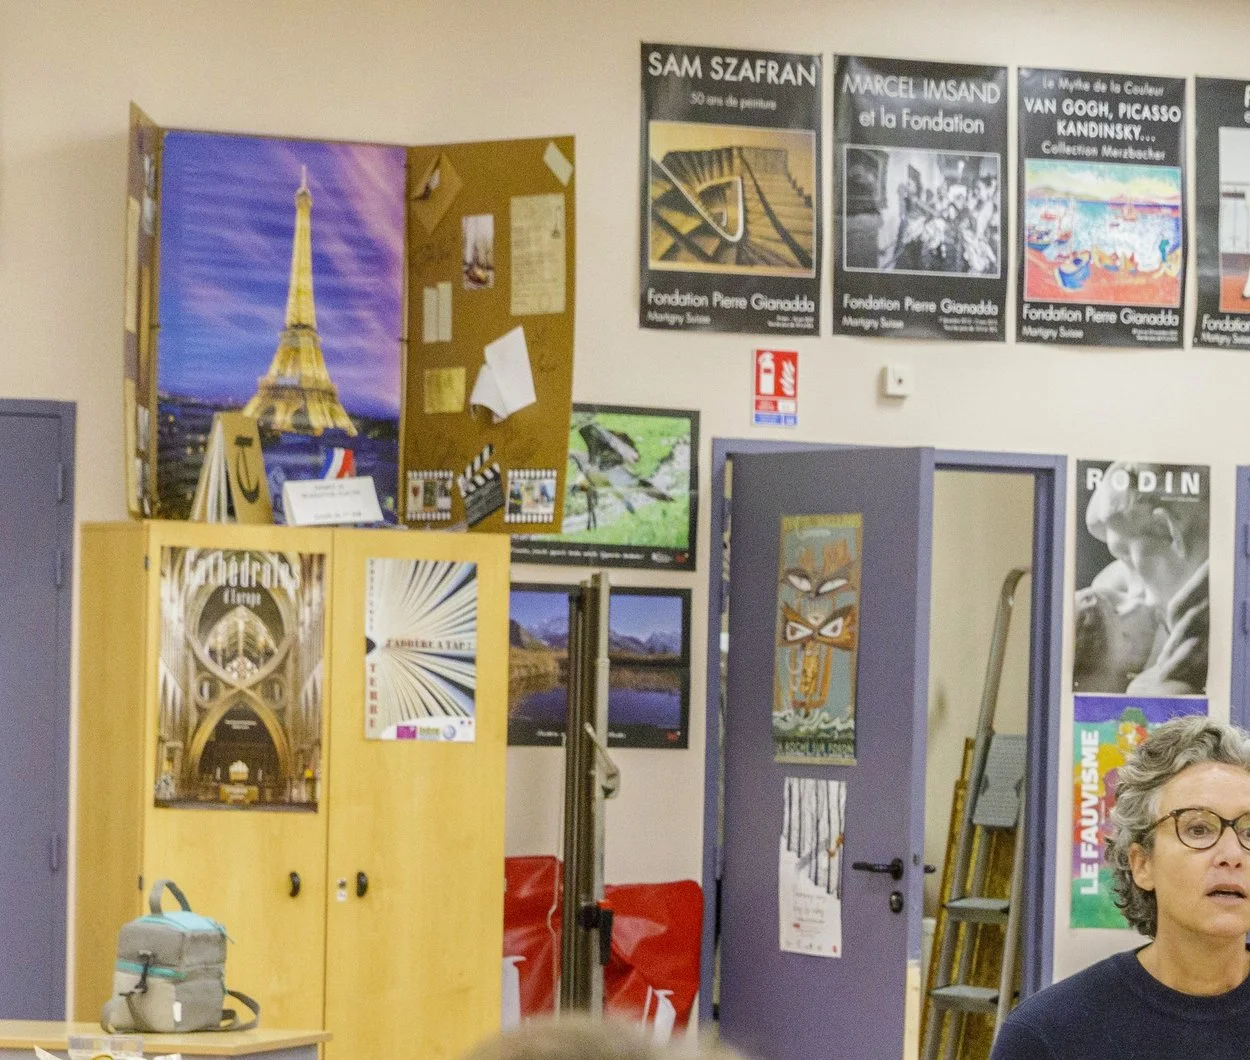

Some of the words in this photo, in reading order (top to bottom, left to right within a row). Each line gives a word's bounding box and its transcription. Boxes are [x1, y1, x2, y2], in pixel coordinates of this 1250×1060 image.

[648, 51, 702, 80] SAM
[710, 55, 816, 87] SZAFRAN
[842, 73, 915, 100] MARCEL
[923, 78, 1001, 105] IMSAND
[1058, 79, 1090, 94] Mythe
[1093, 80, 1107, 93] de
[1124, 81, 1164, 97] Couleur
[860, 110, 876, 127] et
[880, 110, 897, 129] la
[902, 110, 985, 135] Fondation
[1024, 97, 1057, 115] VAN
[1062, 100, 1114, 120] GOGH,
[1119, 102, 1182, 123] PICASSO
[1041, 141, 1098, 158] Collection
[647, 288, 709, 308] Fondation
[712, 291, 748, 309] Pierre
[750, 292, 815, 313] Gianadda
[843, 293, 900, 311] Fondation
[904, 296, 937, 313] Pierre
[940, 298, 999, 316] Gianadda
[1022, 304, 1082, 322] Fondation
[1085, 306, 1117, 324] Pierre
[1119, 308, 1180, 326] Gianadda
[1086, 467, 1200, 495] RODIN
[1080, 730, 1100, 859] FAUVISME
[1080, 863, 1099, 895] LE
